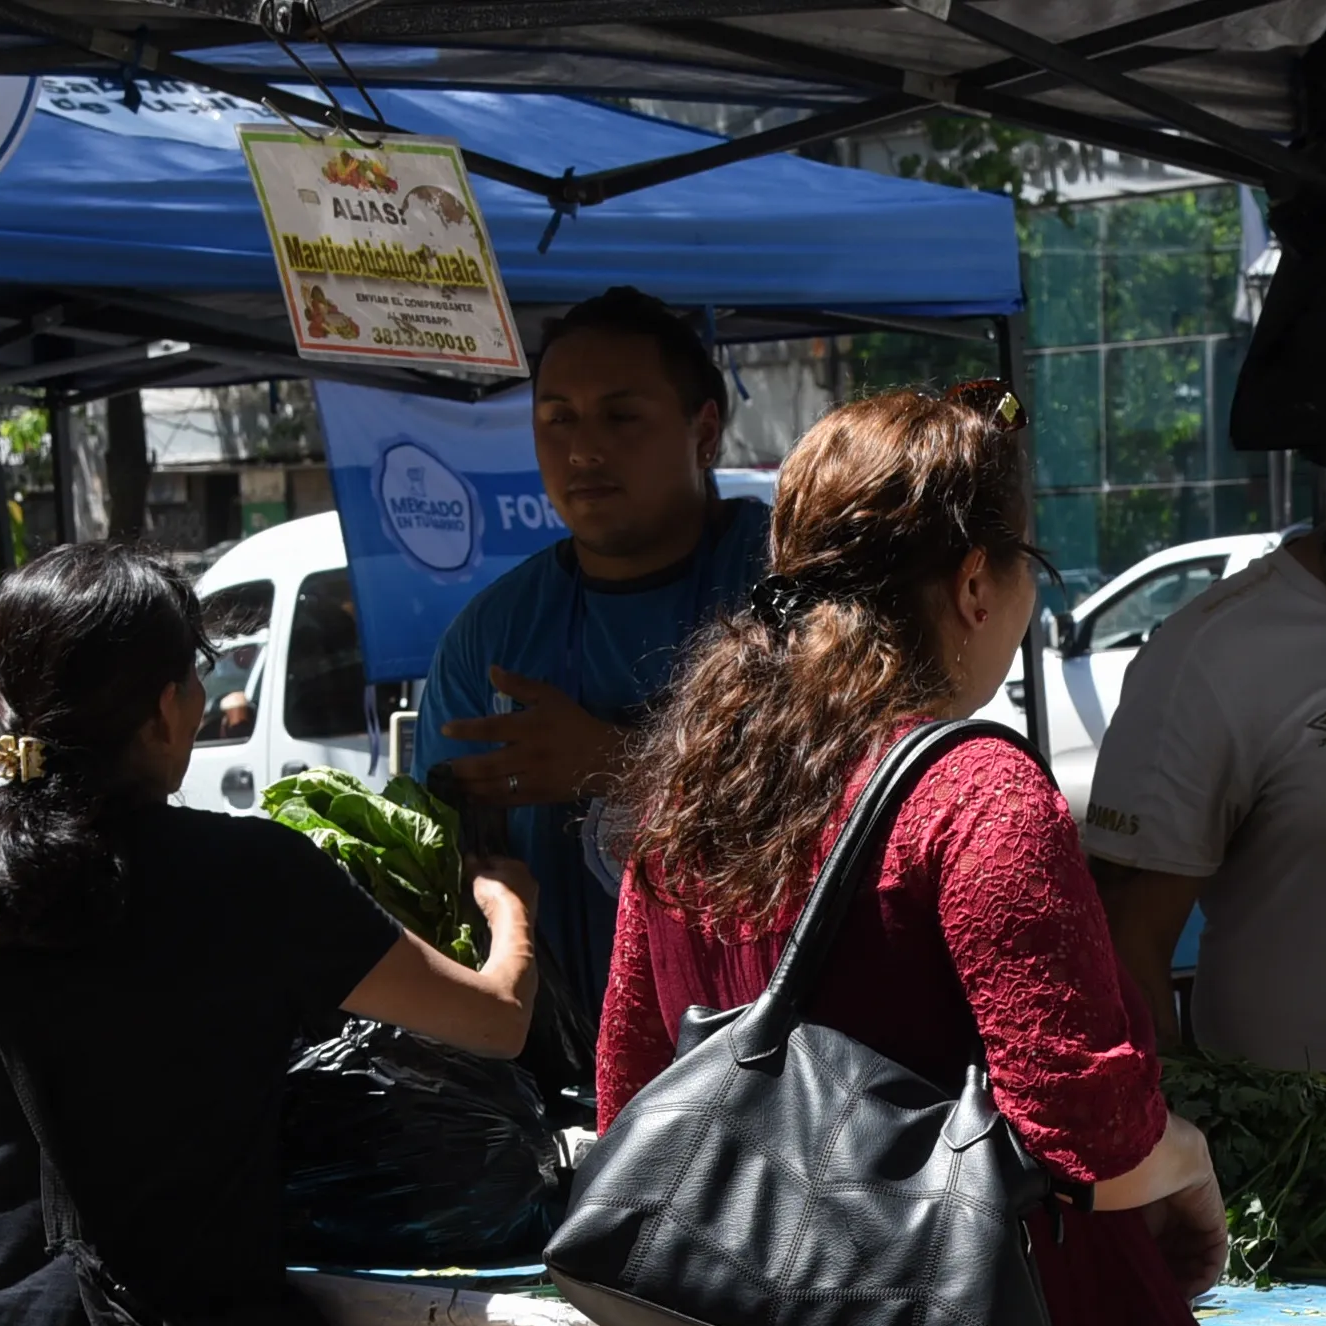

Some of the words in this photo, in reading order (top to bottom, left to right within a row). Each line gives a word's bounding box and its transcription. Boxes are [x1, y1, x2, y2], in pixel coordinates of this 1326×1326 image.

[332, 197, 408, 226] ALIAS:
[355, 292, 389, 305] ENVIAR
[390, 296, 403, 307] EL
